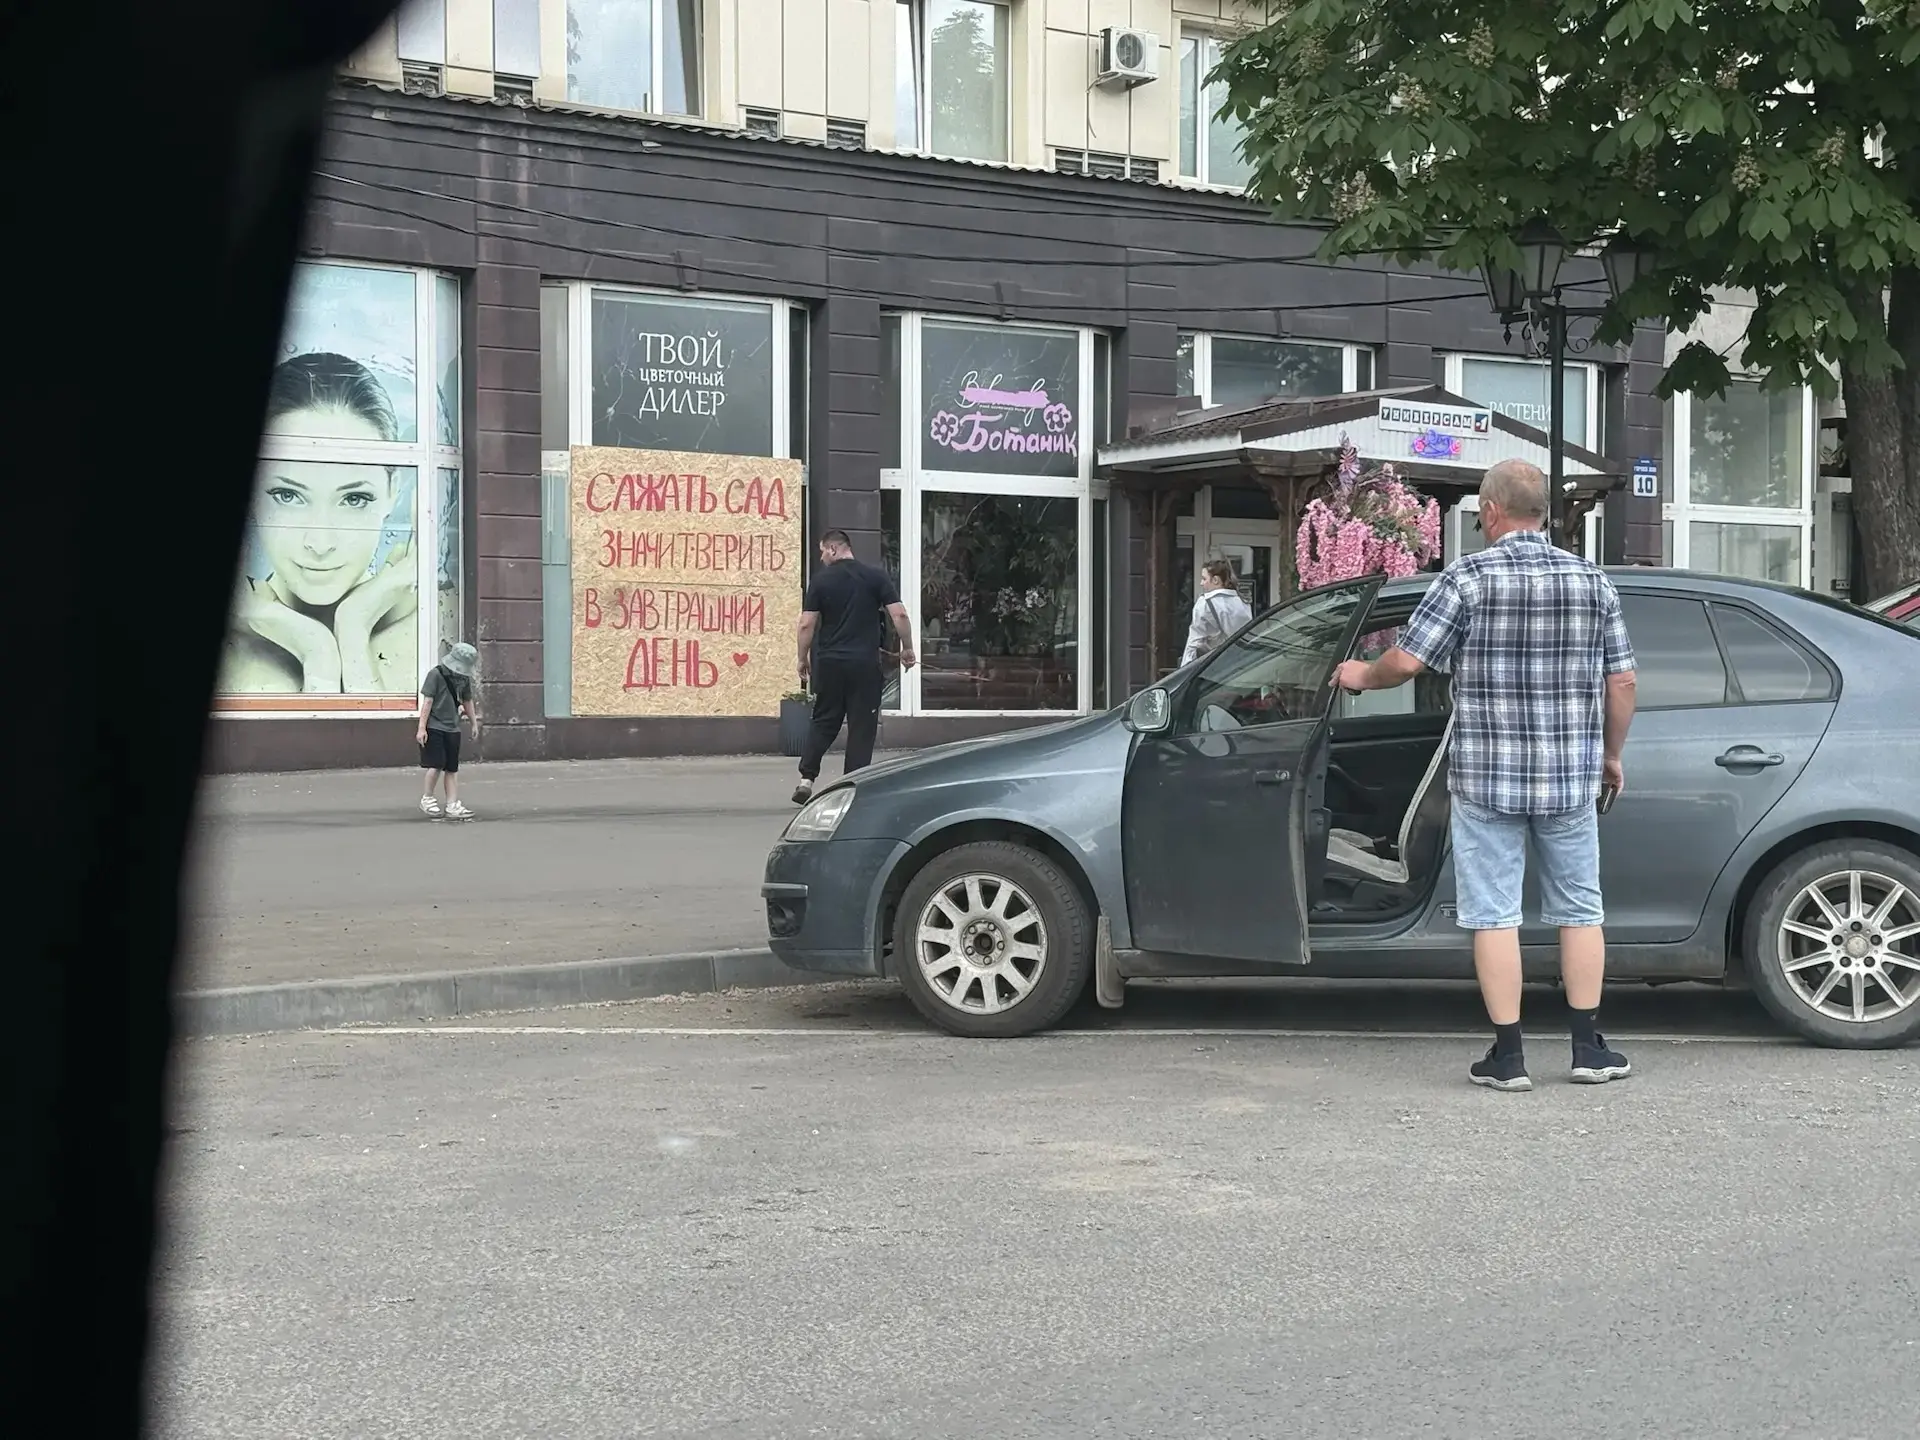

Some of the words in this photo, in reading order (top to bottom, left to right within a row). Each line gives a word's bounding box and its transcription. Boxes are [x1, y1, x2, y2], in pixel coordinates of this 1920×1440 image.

[638, 330, 725, 369] ТВОЙ
[638, 367, 725, 387] ЦВЕТОЧНЫЙ
[638, 386, 726, 420] ДИЛЕР
[1381, 407, 1472, 428] УНИВЕРСАМ
[951, 410, 1078, 458] Ботаник
[586, 472, 718, 514] САЖАТЬ
[725, 476, 788, 521] САД
[1637, 476, 1653, 494] 10
[695, 533, 786, 572] ВЕРИТЬ
[585, 588, 601, 628] В
[608, 588, 766, 635] ЗАВТРАШНИЙ
[623, 637, 719, 693] ДЕНЬ
